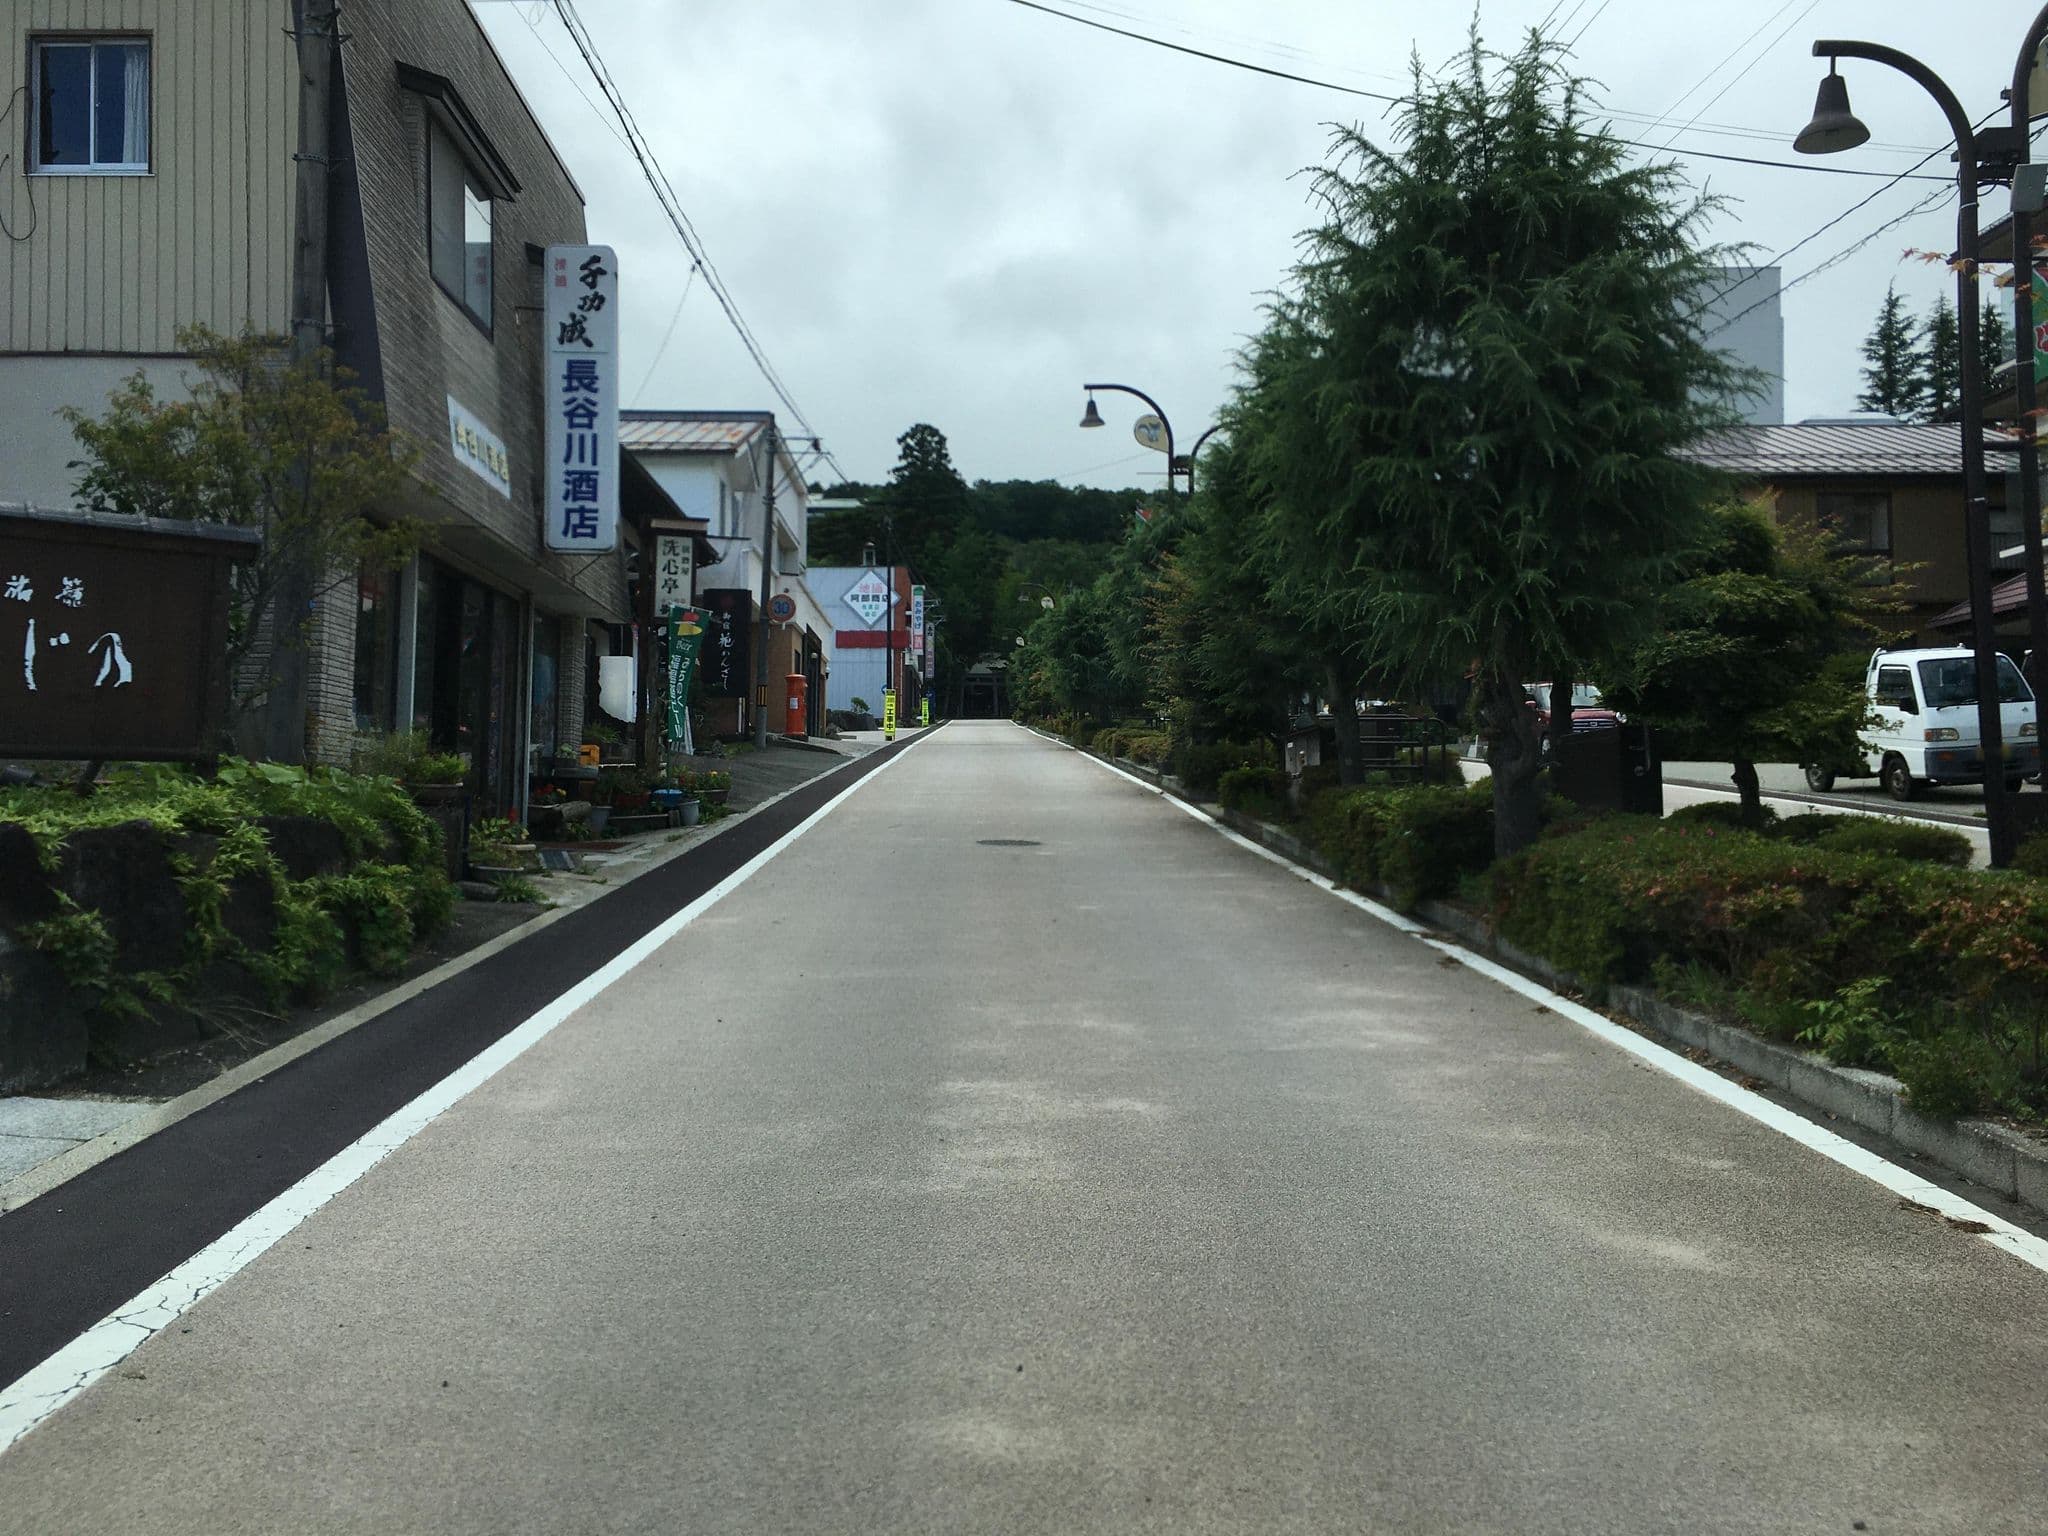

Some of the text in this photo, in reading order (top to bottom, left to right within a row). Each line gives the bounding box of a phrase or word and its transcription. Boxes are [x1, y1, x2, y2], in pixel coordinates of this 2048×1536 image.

[562, 359, 599, 540] 長谷川酒店
[773, 601, 790, 614] 30
